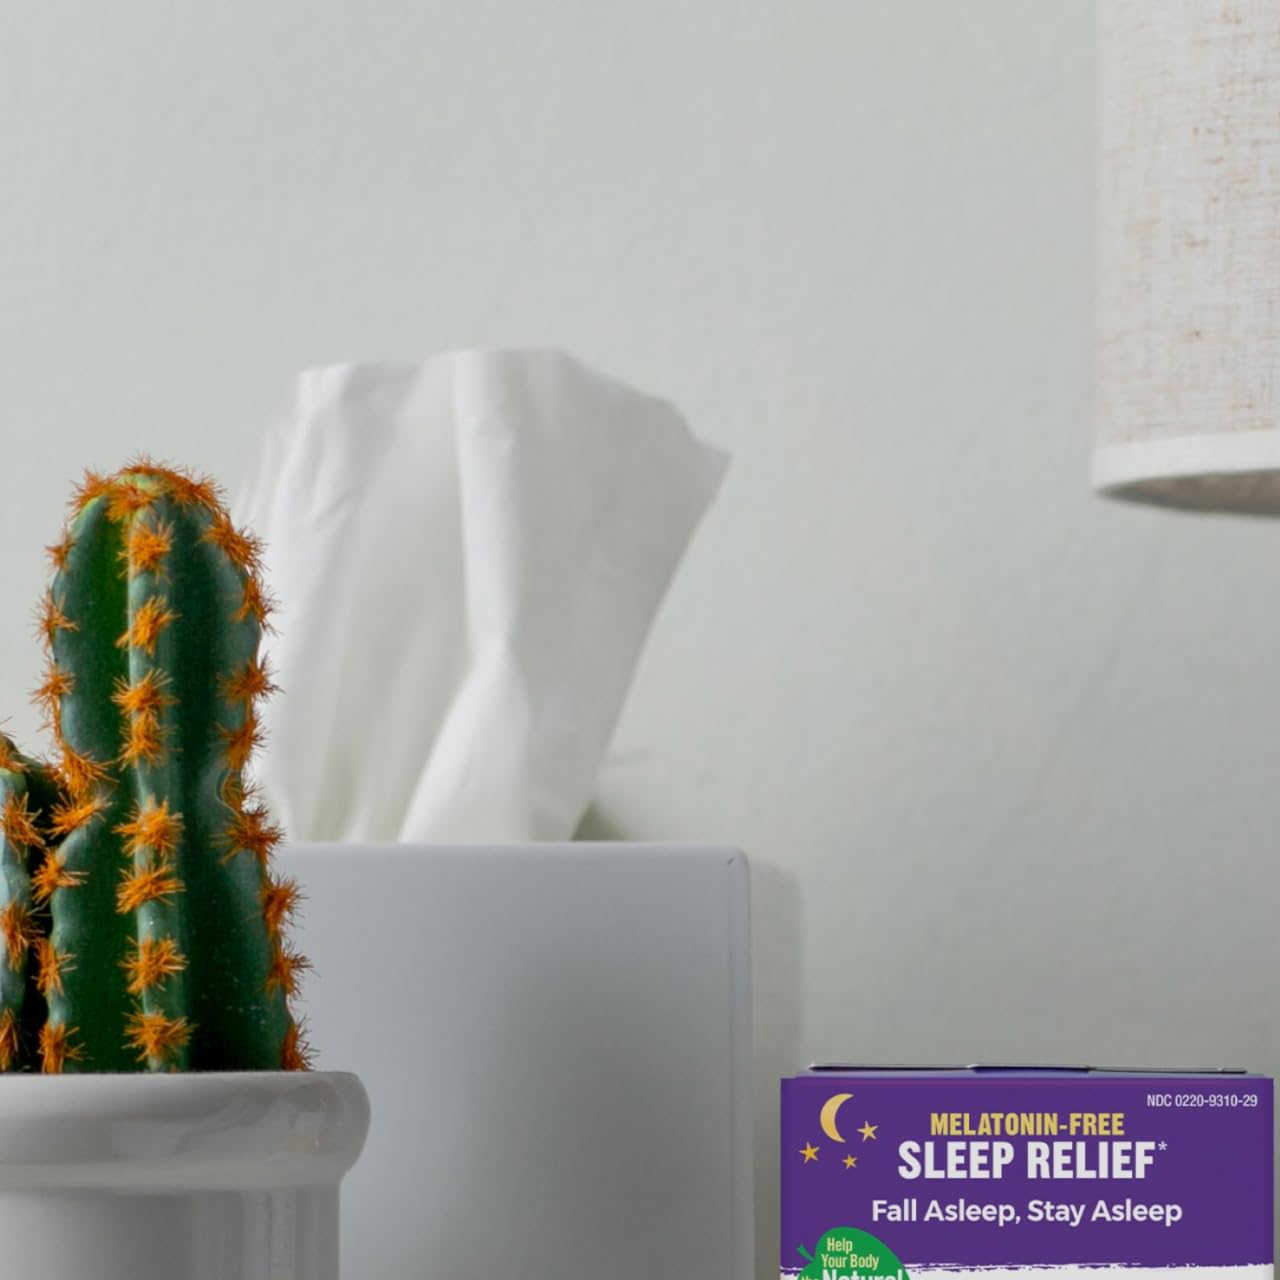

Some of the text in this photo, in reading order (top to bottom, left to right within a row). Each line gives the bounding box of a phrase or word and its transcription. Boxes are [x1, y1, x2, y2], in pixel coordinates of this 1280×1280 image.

[1147, 1095, 1258, 1107] NDC 0220-9310-29
[930, 1112, 1125, 1136] MELATONIN-FREE
[898, 1140, 1015, 1179] SLEEP
[872, 1200, 1182, 1227] Fall Asleep, Stay Asleep
[827, 1238, 853, 1254] Help
[822, 1254, 879, 1270] Your Body
